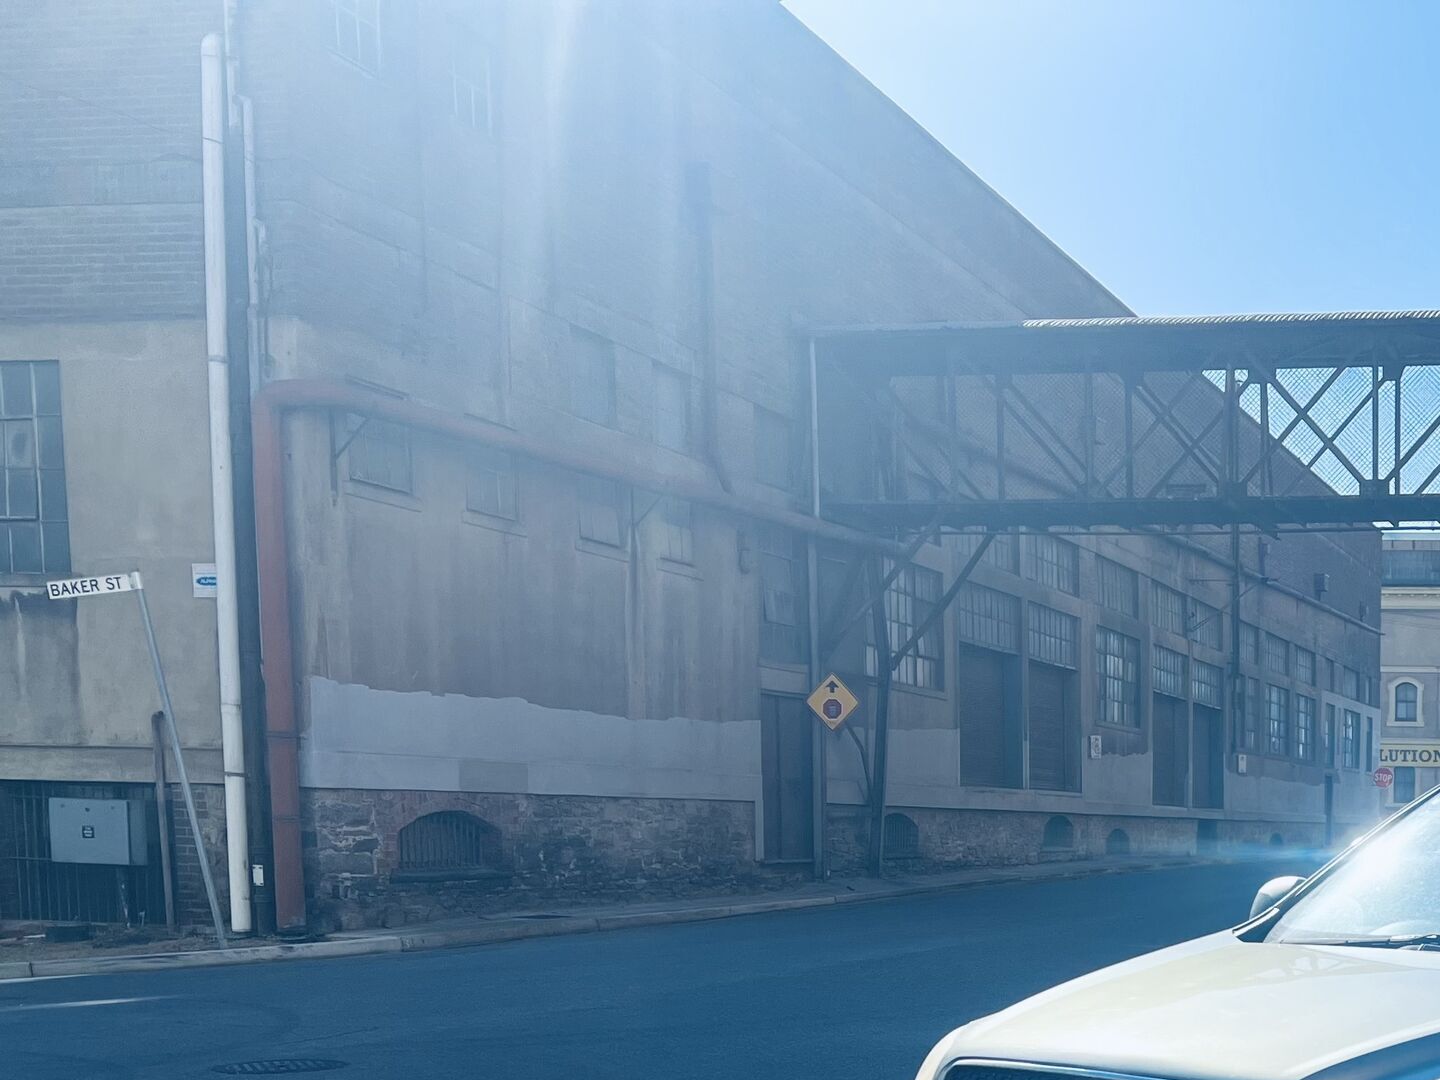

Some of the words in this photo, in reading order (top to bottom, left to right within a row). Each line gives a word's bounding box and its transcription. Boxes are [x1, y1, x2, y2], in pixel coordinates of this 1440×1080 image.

[50, 579, 100, 597] BAKER
[106, 576, 122, 591] ST
[1374, 773, 1393, 783] STOP
